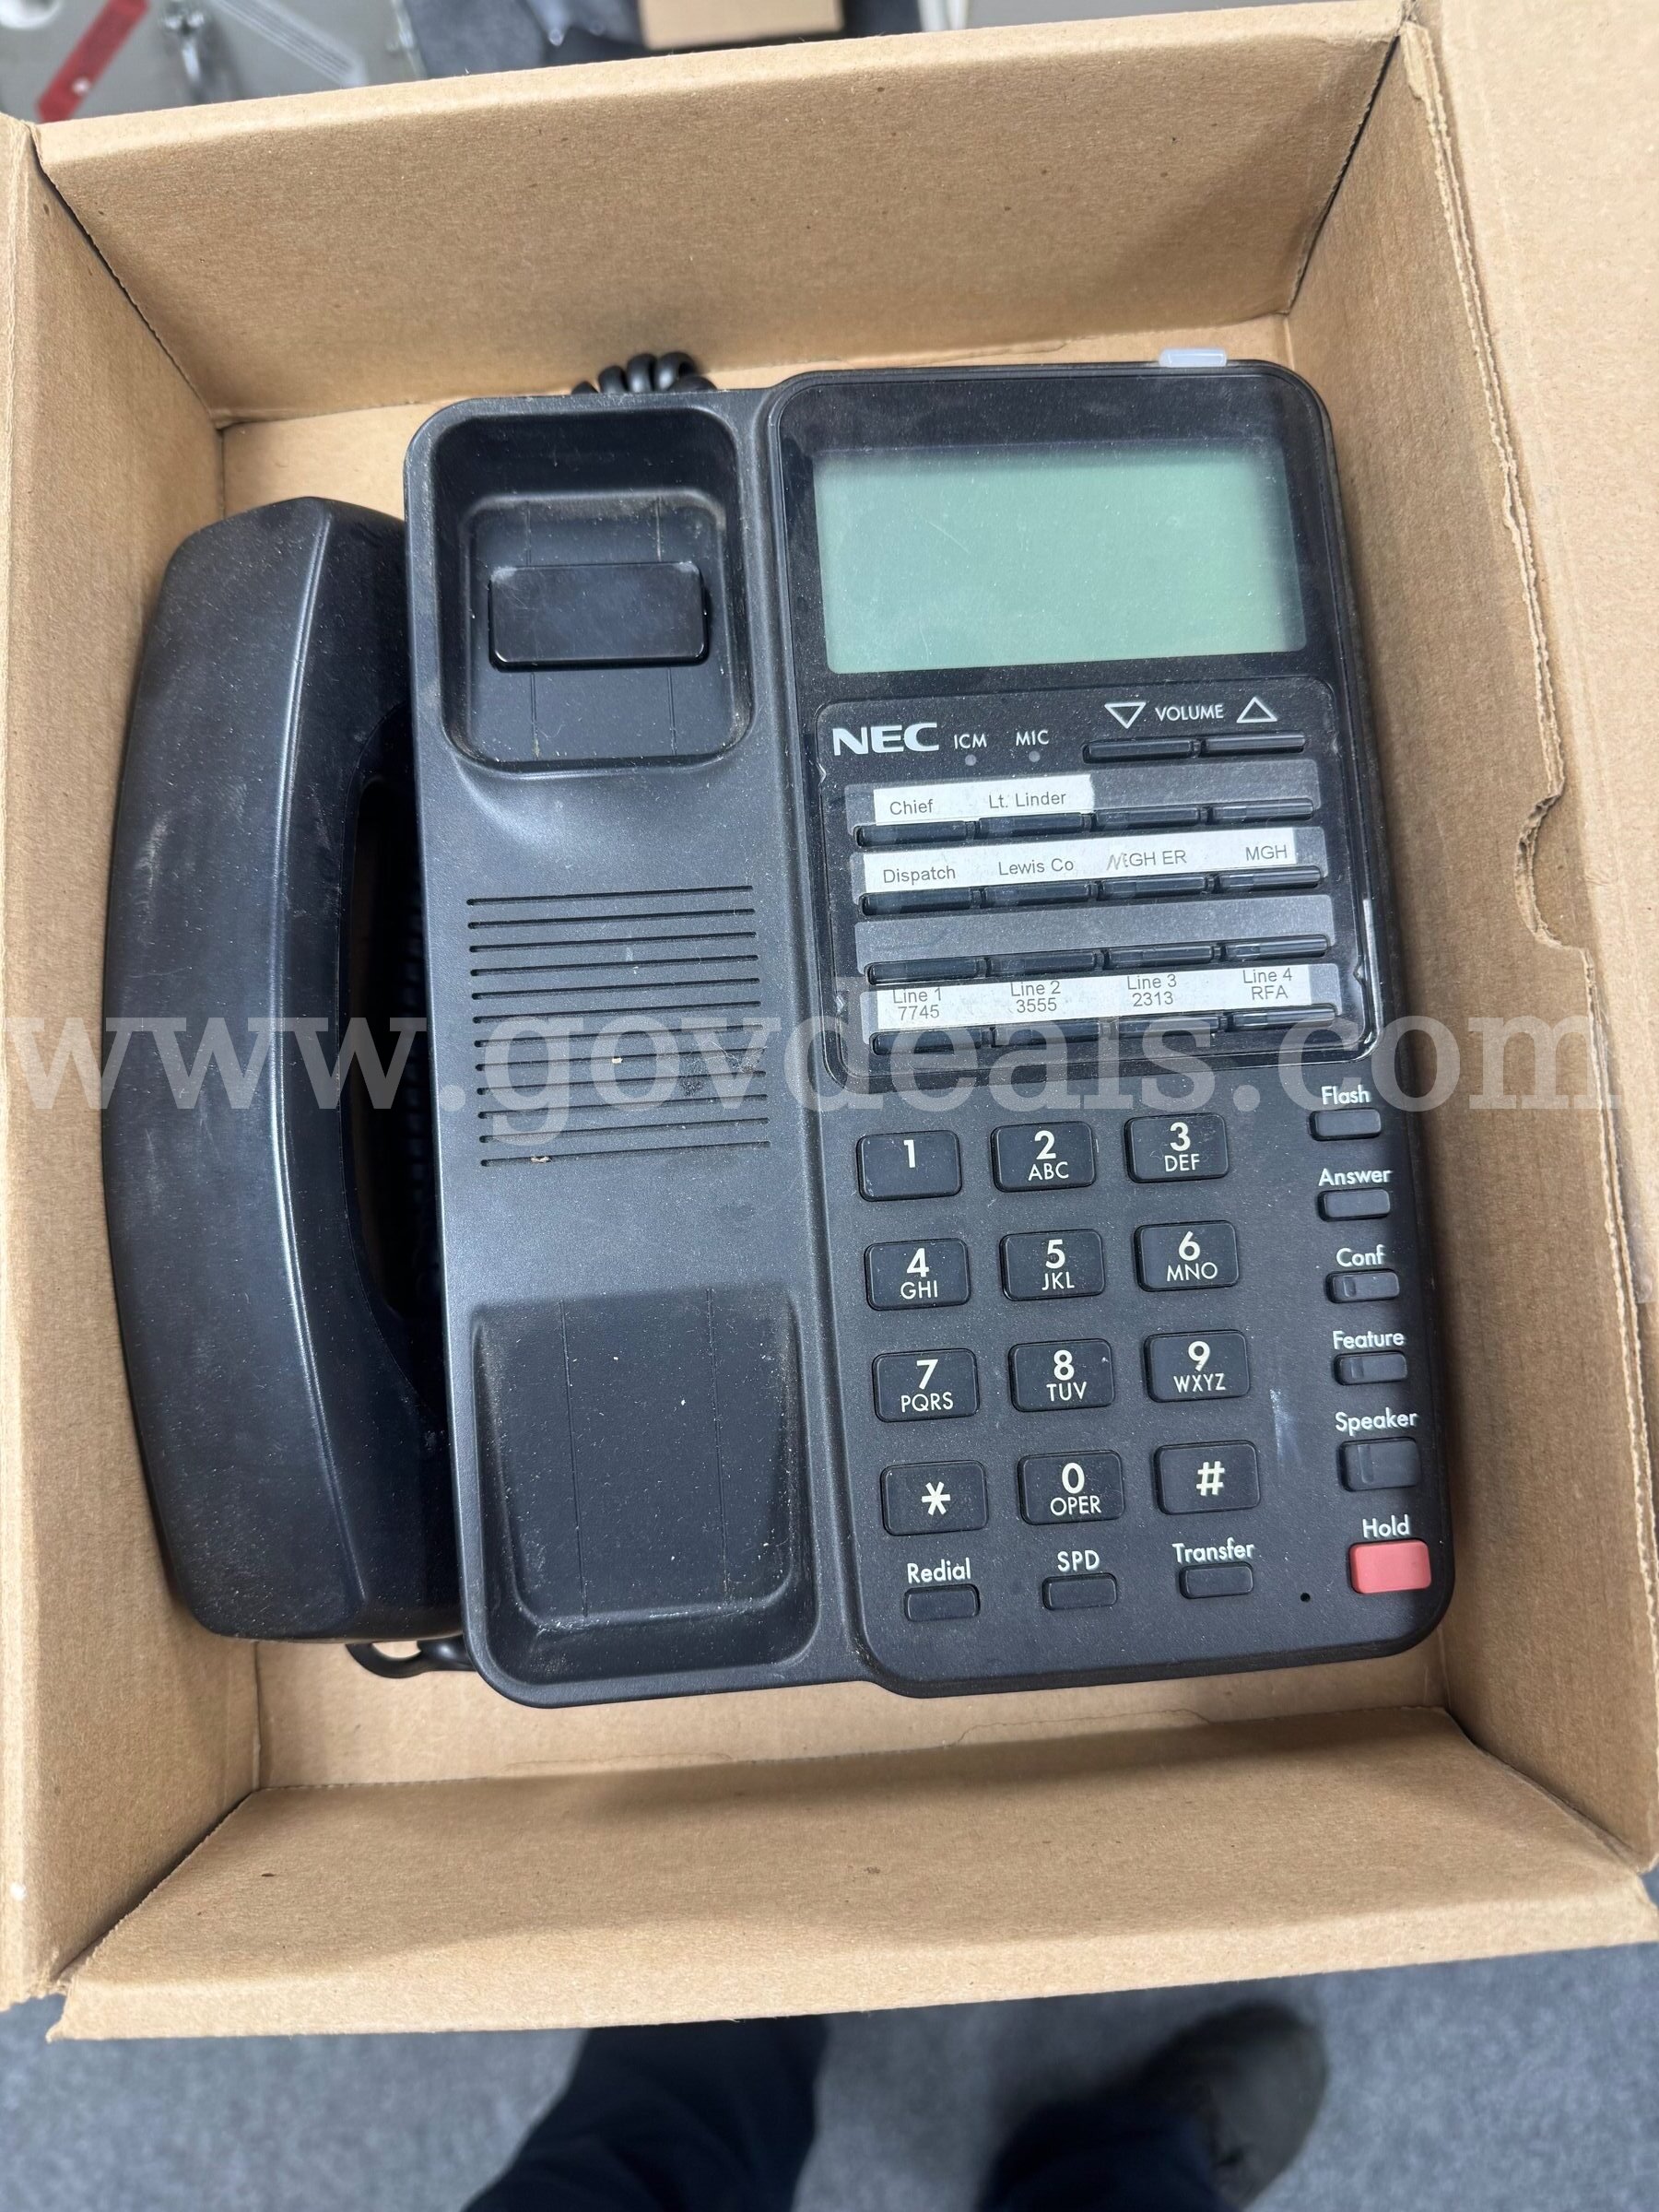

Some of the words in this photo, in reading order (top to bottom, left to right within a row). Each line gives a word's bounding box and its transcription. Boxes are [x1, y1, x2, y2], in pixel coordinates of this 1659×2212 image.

[1155, 704, 1225, 722] VOLUME
[832, 723, 940, 756] NEC
[953, 734, 987, 749] ICM
[1016, 729, 1050, 746] MIC
[889, 798, 934, 816] Chief
[989, 794, 1008, 809] Lt.
[1016, 791, 1066, 807] Linder
[1162, 850, 1187, 865] ER
[1245, 844, 1288, 861] MGH
[883, 865, 956, 886] Dispatch
[998, 859, 1045, 876] Lewis
[1051, 857, 1075, 872] Co
[1126, 975, 1163, 990] Line
[1167, 973, 1178, 988] 3
[1242, 969, 1278, 984] Line
[1282, 968, 1293, 982] 4
[892, 989, 929, 1004] Line
[934, 987, 942, 1001] 1
[1010, 982, 1046, 997] Line
[1050, 980, 1062, 994] 2
[1252, 985, 1288, 1000] RFA
[1016, 997, 1058, 1013] 3555
[1132, 991, 1174, 1007] 2313
[898, 1004, 940, 1020] 7745
[1321, 1085, 1372, 1105] Flash
[1034, 1130, 1057, 1160] 2
[1170, 1122, 1191, 1151] 3
[903, 1139, 916, 1169] 1
[1164, 1154, 1200, 1172] DEF
[1028, 1161, 1069, 1182] ABC
[1318, 1168, 1392, 1186] Answer
[1045, 1239, 1065, 1269] 5
[1178, 1230, 1201, 1262] 6
[1335, 1244, 1385, 1267] Conf
[906, 1247, 930, 1278] 4
[1166, 1262, 1218, 1282] MNO
[900, 1279, 938, 1300] GHI
[1041, 1272, 1075, 1291] JKL
[1332, 1330, 1406, 1350] Feature
[1053, 1349, 1075, 1381] 8
[1187, 1340, 1211, 1371] 9
[916, 1359, 938, 1390] 7
[1173, 1372, 1227, 1394] WXYZ
[1046, 1382, 1087, 1401] TUV
[900, 1392, 954, 1412] PQRS
[1335, 1407, 1418, 1437] Speaker
[1061, 1462, 1085, 1494] 0
[1195, 1460, 1226, 1496] #
[1050, 1495, 1102, 1516] OPER
[1361, 1514, 1411, 1538] Hold
[1057, 1549, 1100, 1571] SPD
[1171, 1537, 1255, 1563] Transfer
[906, 1558, 972, 1584] Redial
